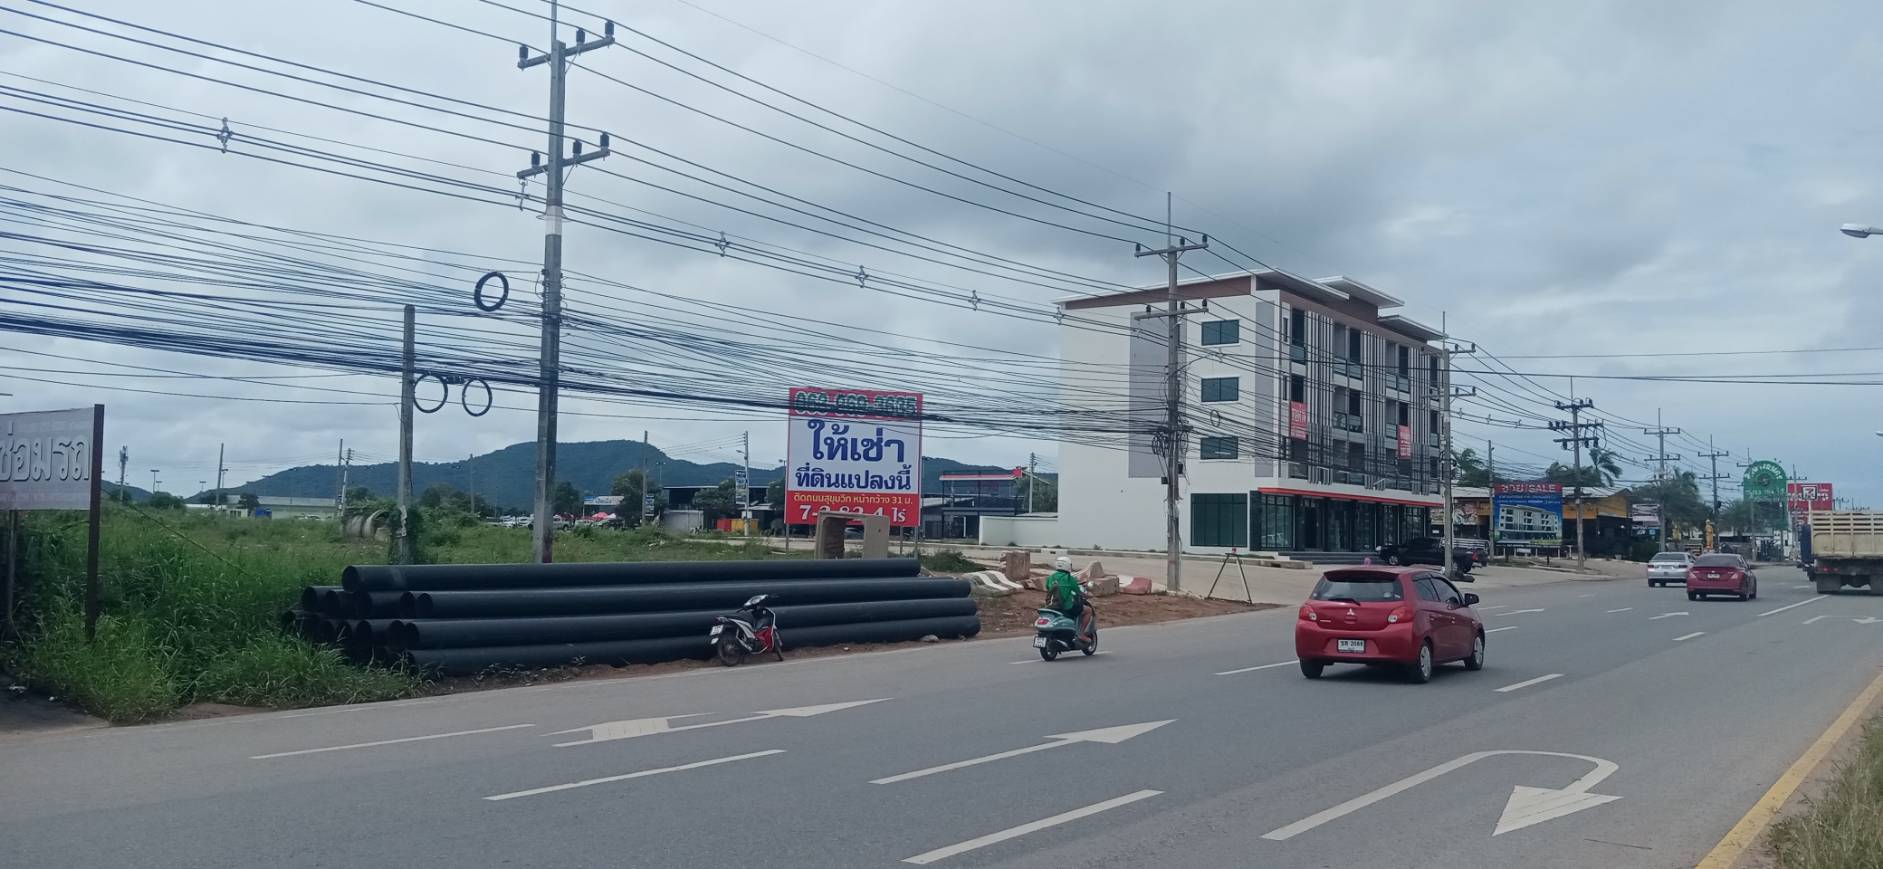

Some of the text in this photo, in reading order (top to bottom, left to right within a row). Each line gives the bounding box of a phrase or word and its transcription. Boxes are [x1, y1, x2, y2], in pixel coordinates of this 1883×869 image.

[807, 418, 905, 463] ให้เช่า
[795, 462, 912, 491] ที่ดินแปลงนี้
[853, 494, 890, 504] หน้ากว้าง
[892, 496, 903, 504] 31
